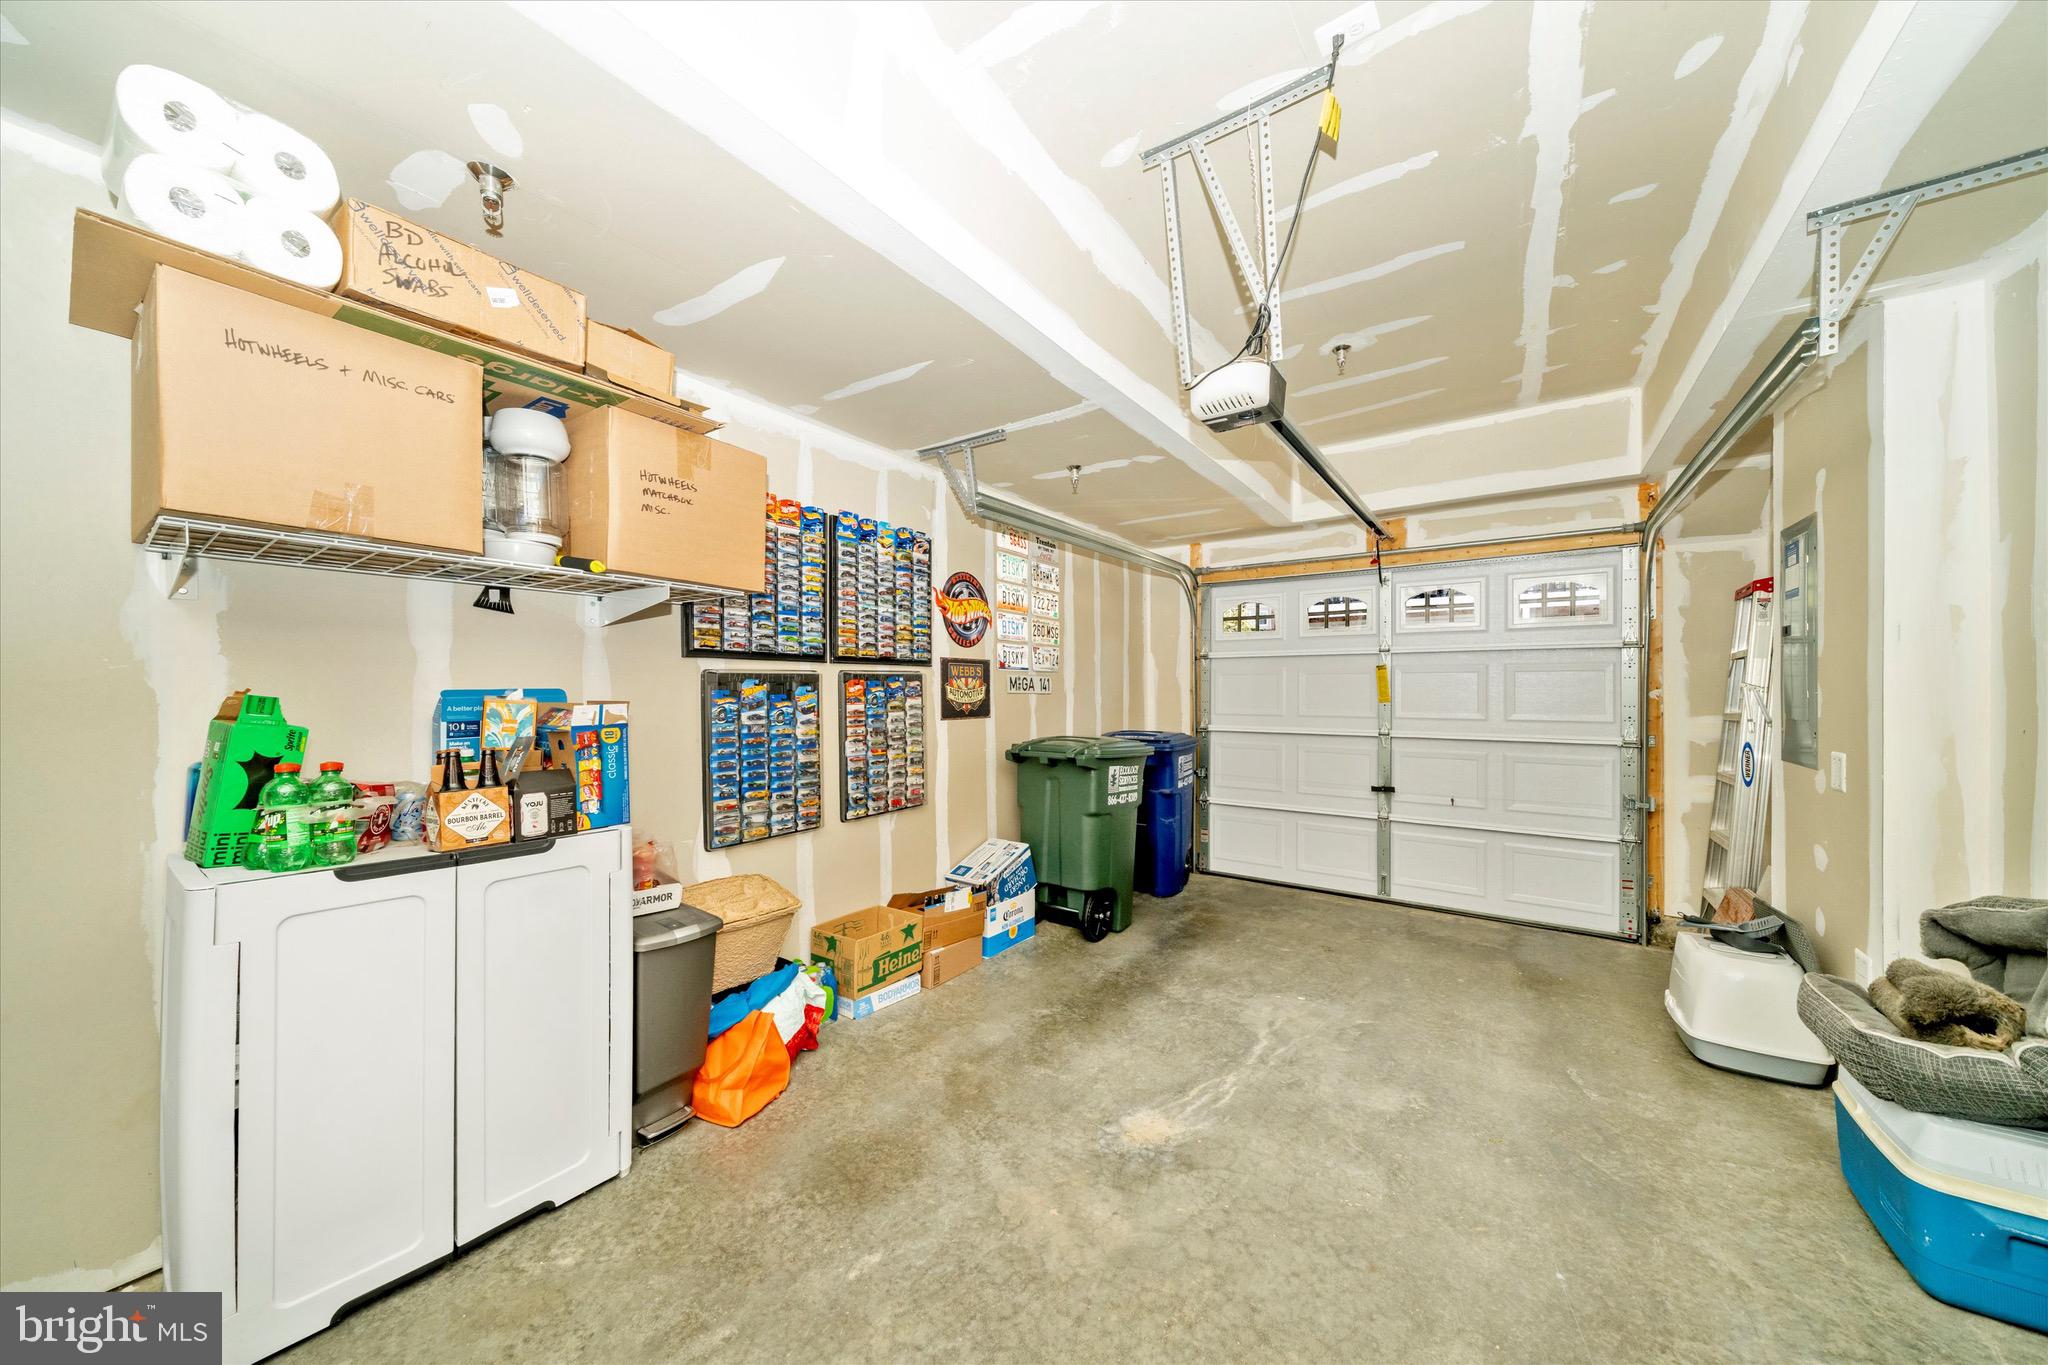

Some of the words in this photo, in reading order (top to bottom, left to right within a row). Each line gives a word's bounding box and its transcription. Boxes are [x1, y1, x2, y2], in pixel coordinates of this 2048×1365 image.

[385, 221, 423, 246] BD
[378, 241, 468, 277] ALCOHOL
[382, 267, 454, 298] SWABS
[224, 327, 329, 371] HOTWHEELS
[414, 385, 455, 404] CARS
[1002, 590, 1025, 608] BISKY
[1001, 620, 1025, 636] BISKY
[1002, 648, 1025, 666] BISKY
[950, 665, 982, 677] WEBB'S
[949, 687, 984, 699] AUTOMOTIVE
[1039, 677, 1051, 692] 141
[448, 723, 460, 731] 10
[605, 730, 614, 740] 18
[284, 729, 297, 752] Sprite
[606, 745, 617, 779] classic
[1744, 750, 1752, 779] WERNER
[447, 815, 479, 825] BOURBON
[480, 811, 504, 821] BARREL
[213, 832, 231, 865] mini
[1003, 906, 1024, 922] Corona
